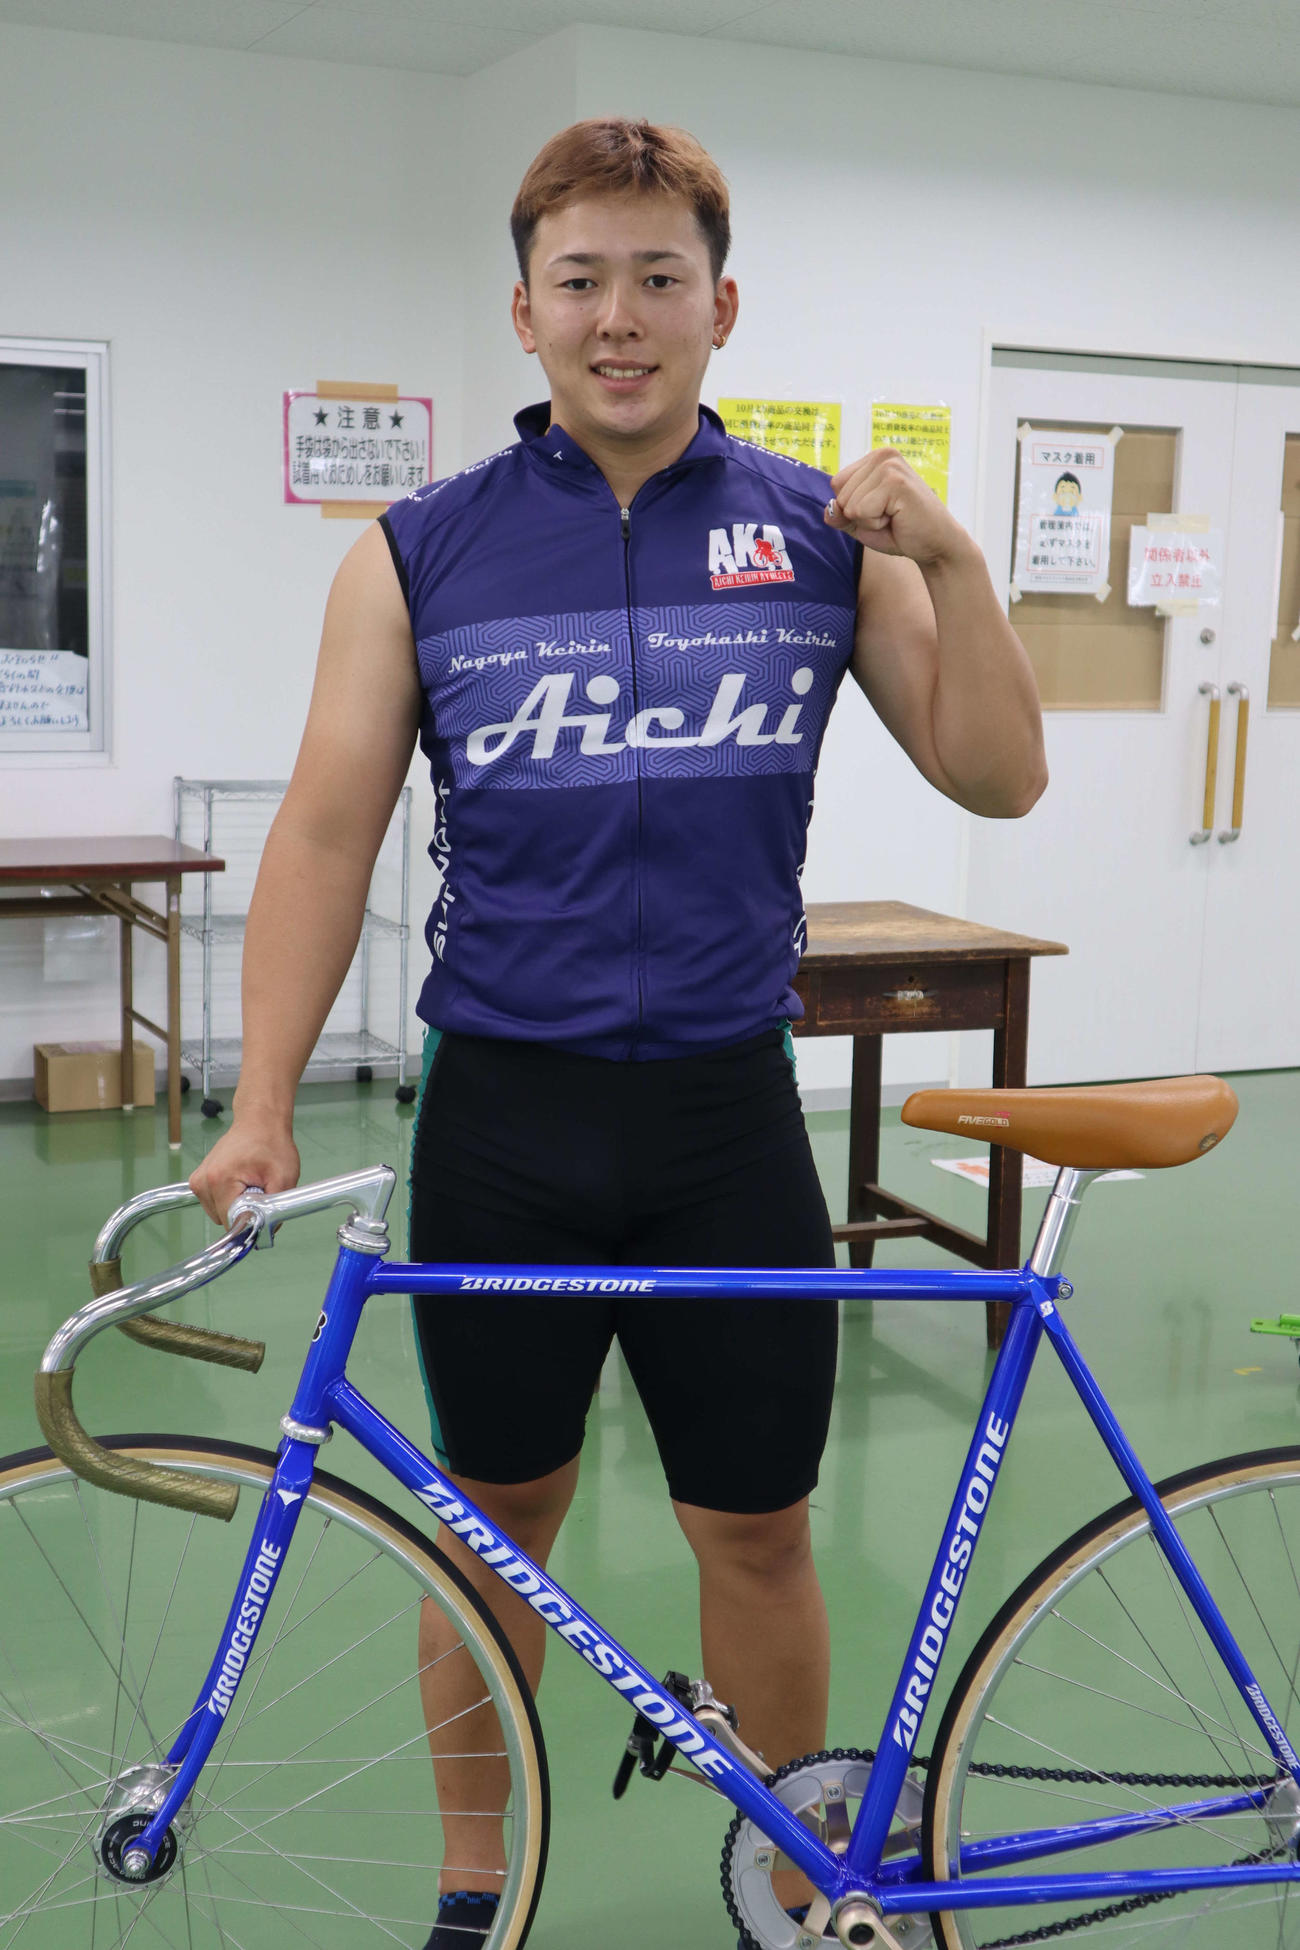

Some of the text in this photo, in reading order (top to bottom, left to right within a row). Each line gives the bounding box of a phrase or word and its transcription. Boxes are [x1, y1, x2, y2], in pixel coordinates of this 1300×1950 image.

[1041, 451, 1096, 465] マスク着用
[1144, 546, 1211, 563] 関係者以外
[1151, 572, 1204, 589] 立入禁止
[648, 628, 838, 651] Toyohashi Keirin
[448, 639, 612, 674] Nagoya Keirin
[466, 667, 814, 766] Aichi
[459, 1277, 657, 1293] BRIDGESTONE
[893, 1411, 1009, 1752] BRIDGESTONE
[207, 1538, 281, 1719] BRIDGESTONE
[411, 1482, 734, 1779] BRIDGESTONE
